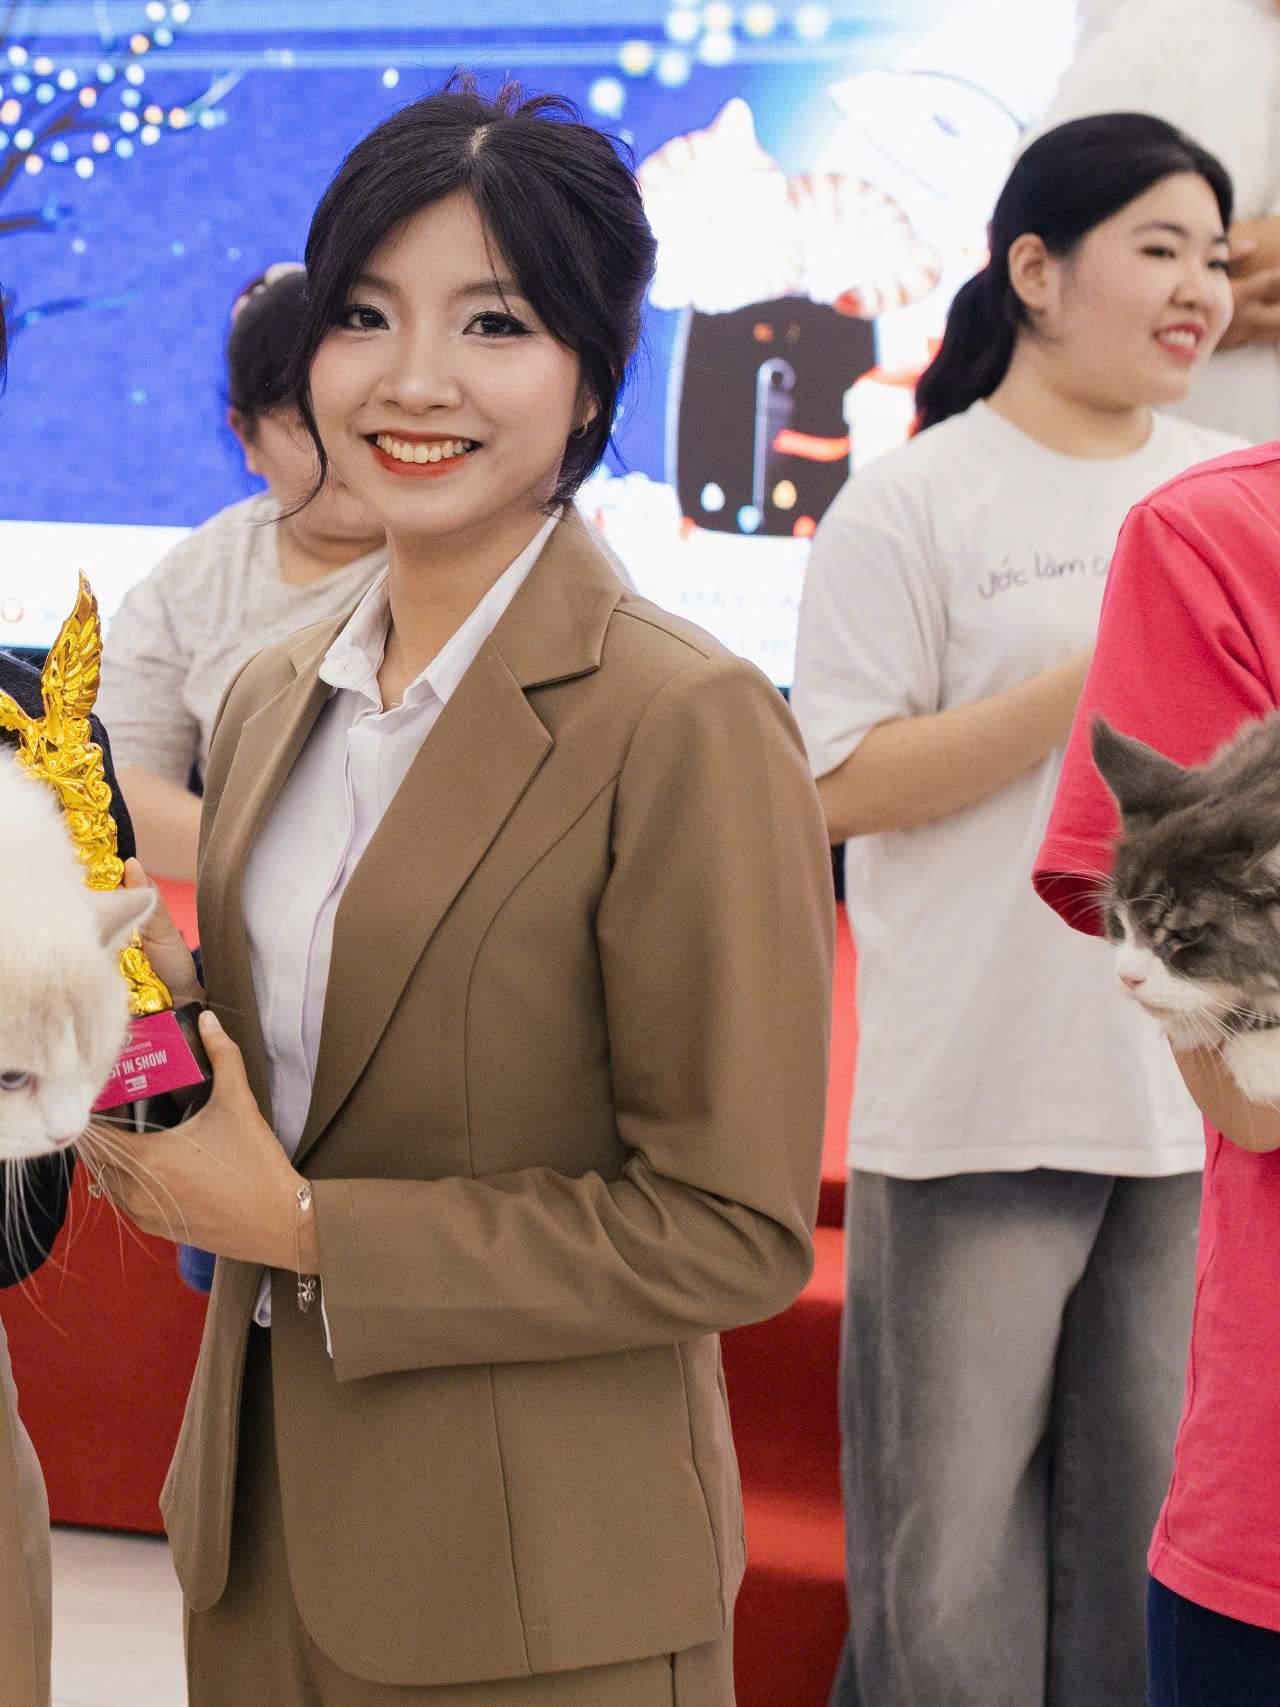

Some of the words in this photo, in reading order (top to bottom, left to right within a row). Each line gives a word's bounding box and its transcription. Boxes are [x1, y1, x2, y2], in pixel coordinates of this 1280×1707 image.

[107, 1065, 121, 1079] ST
[122, 1060, 135, 1075] IN
[134, 1050, 168, 1072] SHOW
